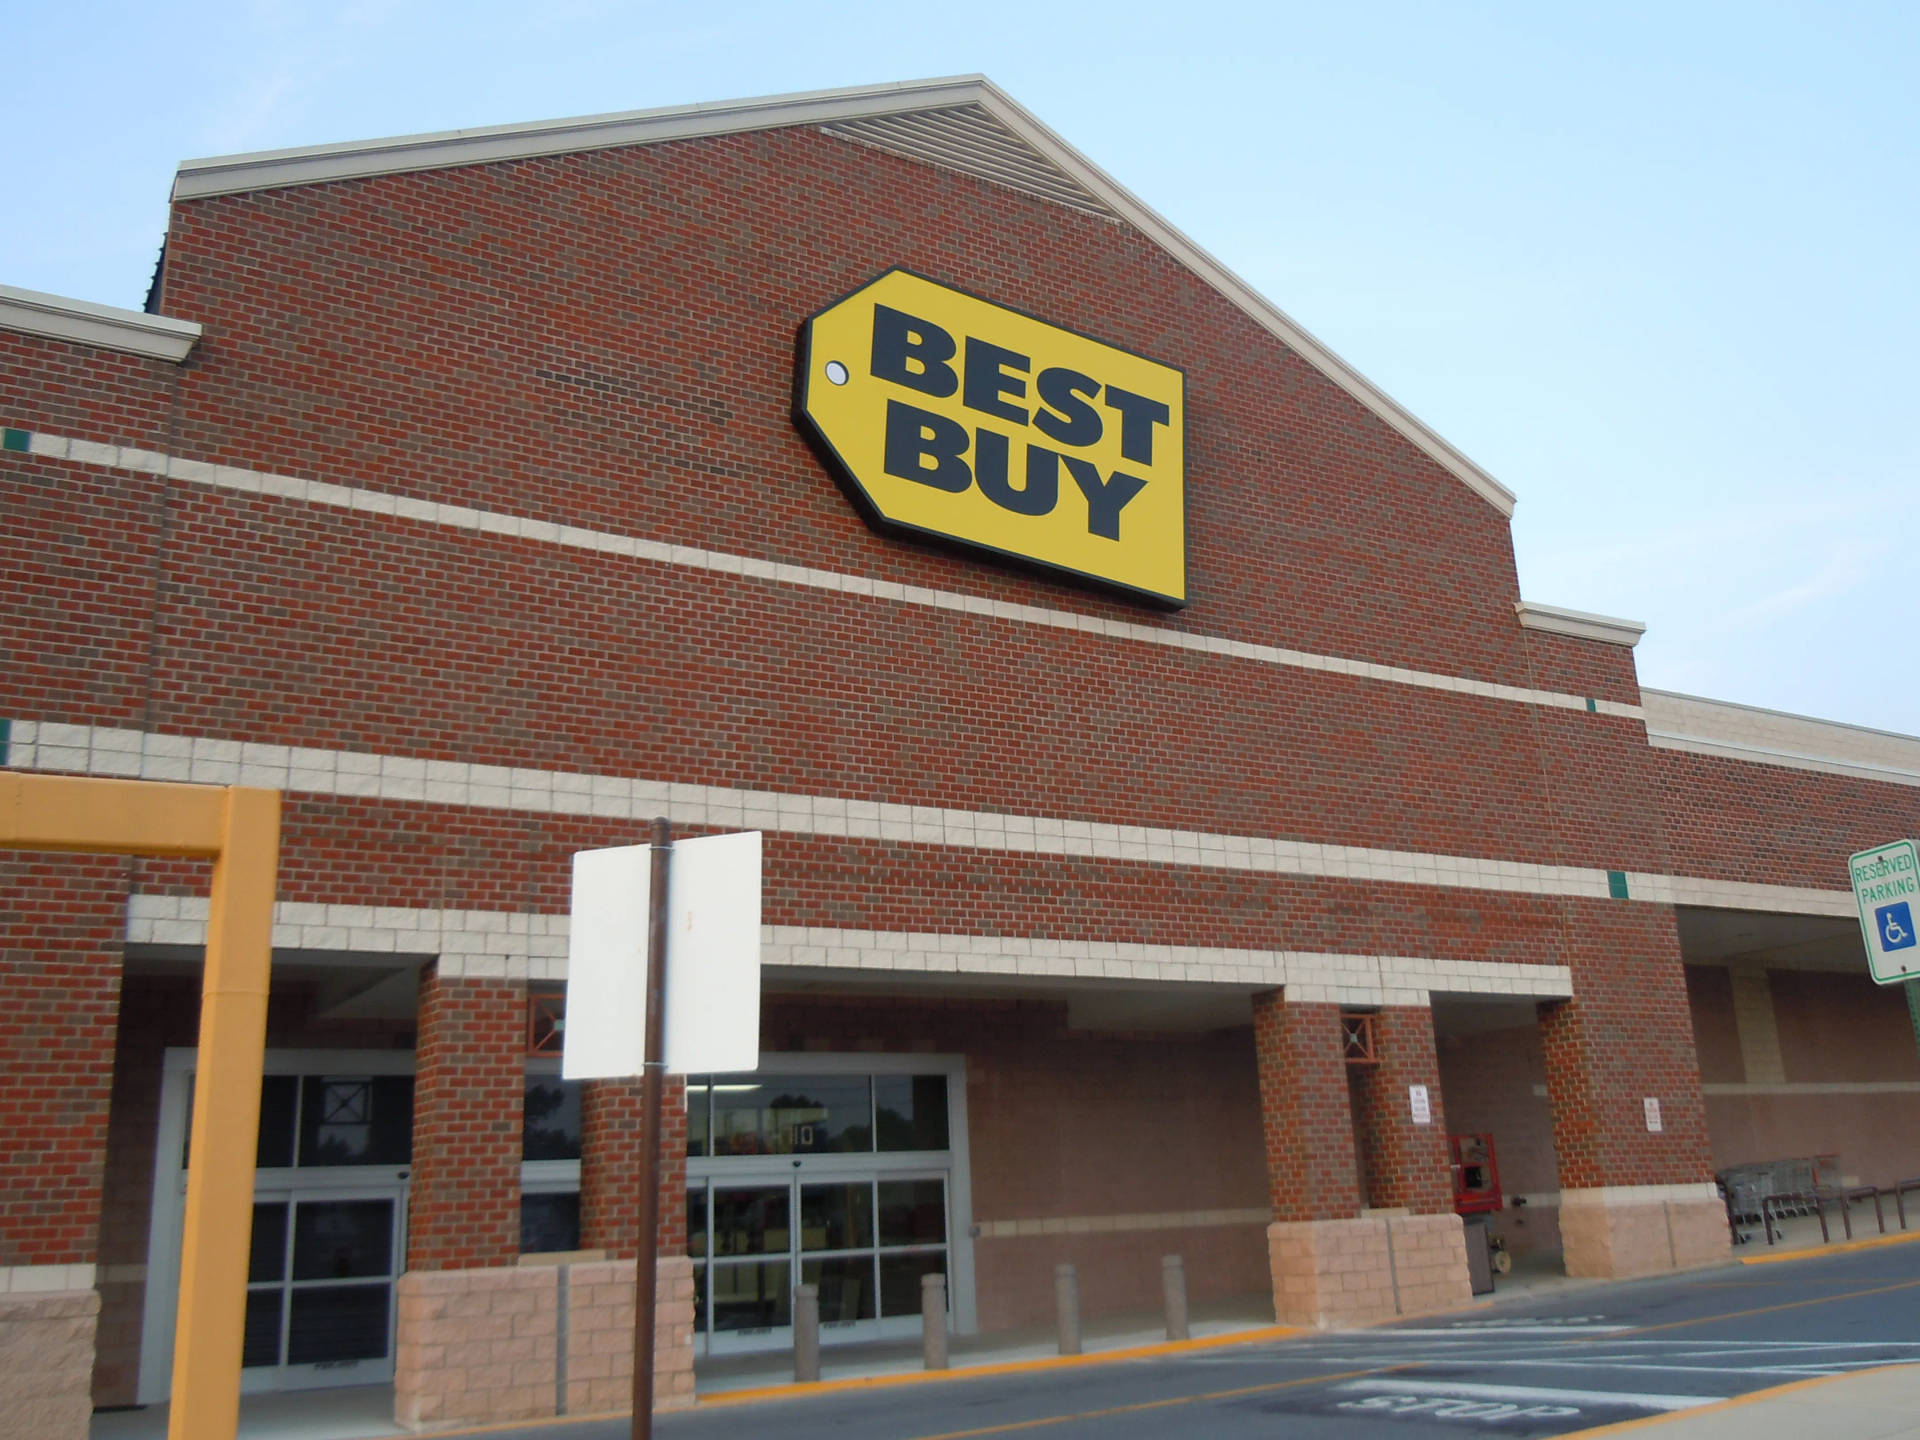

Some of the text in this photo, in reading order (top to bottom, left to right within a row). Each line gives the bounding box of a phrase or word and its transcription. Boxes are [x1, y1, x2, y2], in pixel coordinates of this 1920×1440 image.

[870, 302, 1170, 467] BEST
[884, 398, 1149, 542] BUY
[1854, 854, 1912, 883] RESERVED
[1861, 876, 1915, 904] PARKING
[1337, 1395, 1580, 1421] STOP
